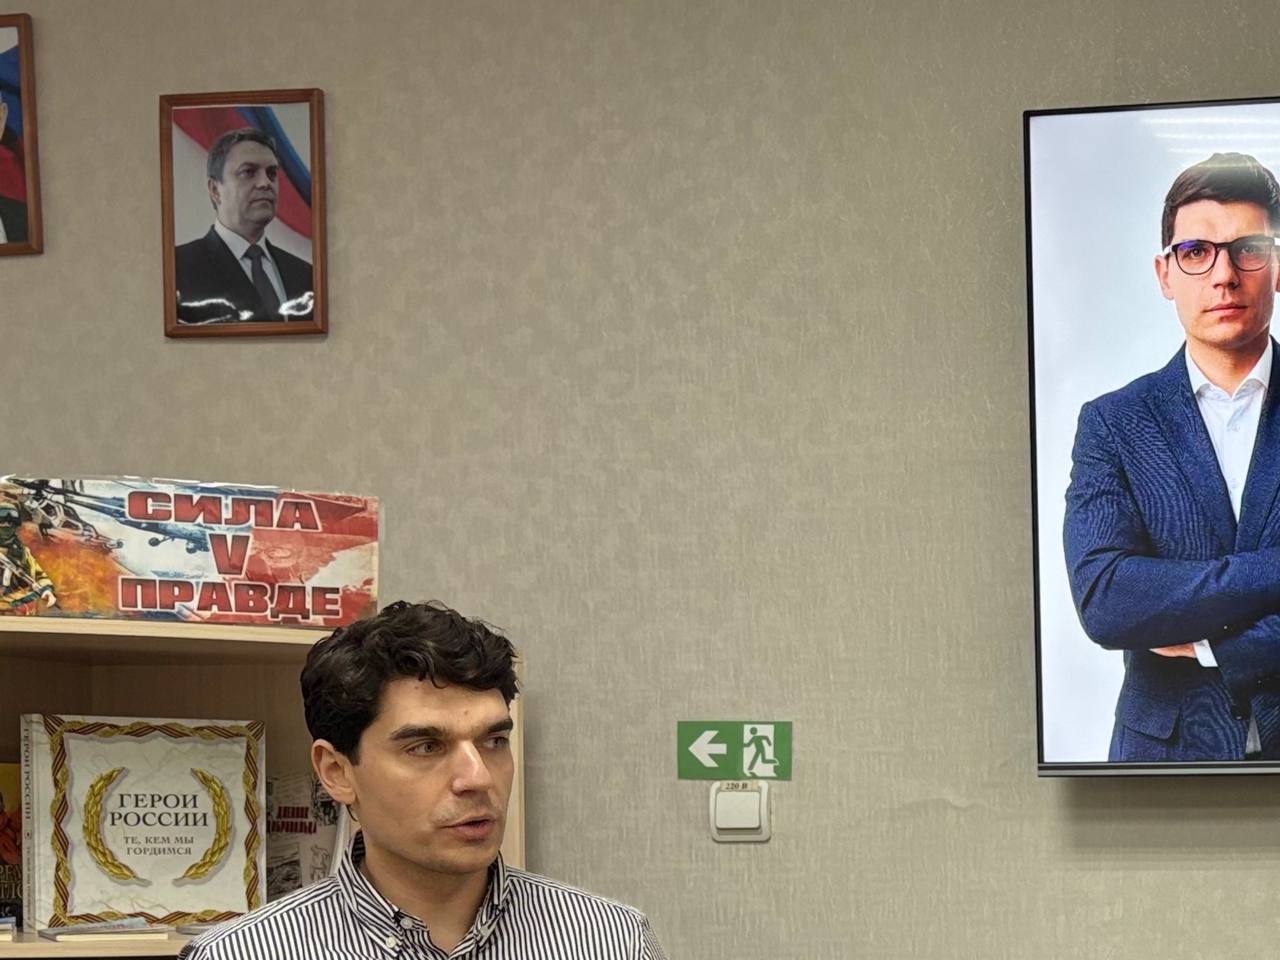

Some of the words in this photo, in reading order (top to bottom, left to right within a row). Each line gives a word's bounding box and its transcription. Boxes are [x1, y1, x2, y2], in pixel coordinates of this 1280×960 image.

[126, 490, 321, 531] СИЛА
[208, 532, 255, 576] V
[117, 577, 342, 620] ПРАВДЕ
[117, 791, 199, 809] ГЕРОИ
[108, 809, 209, 827] РОССИИ
[123, 836, 141, 847] ТЕ,
[145, 836, 170, 845] КЕМ
[174, 836, 194, 845] МЫ
[126, 846, 193, 857] ГОРДИМСЯ
